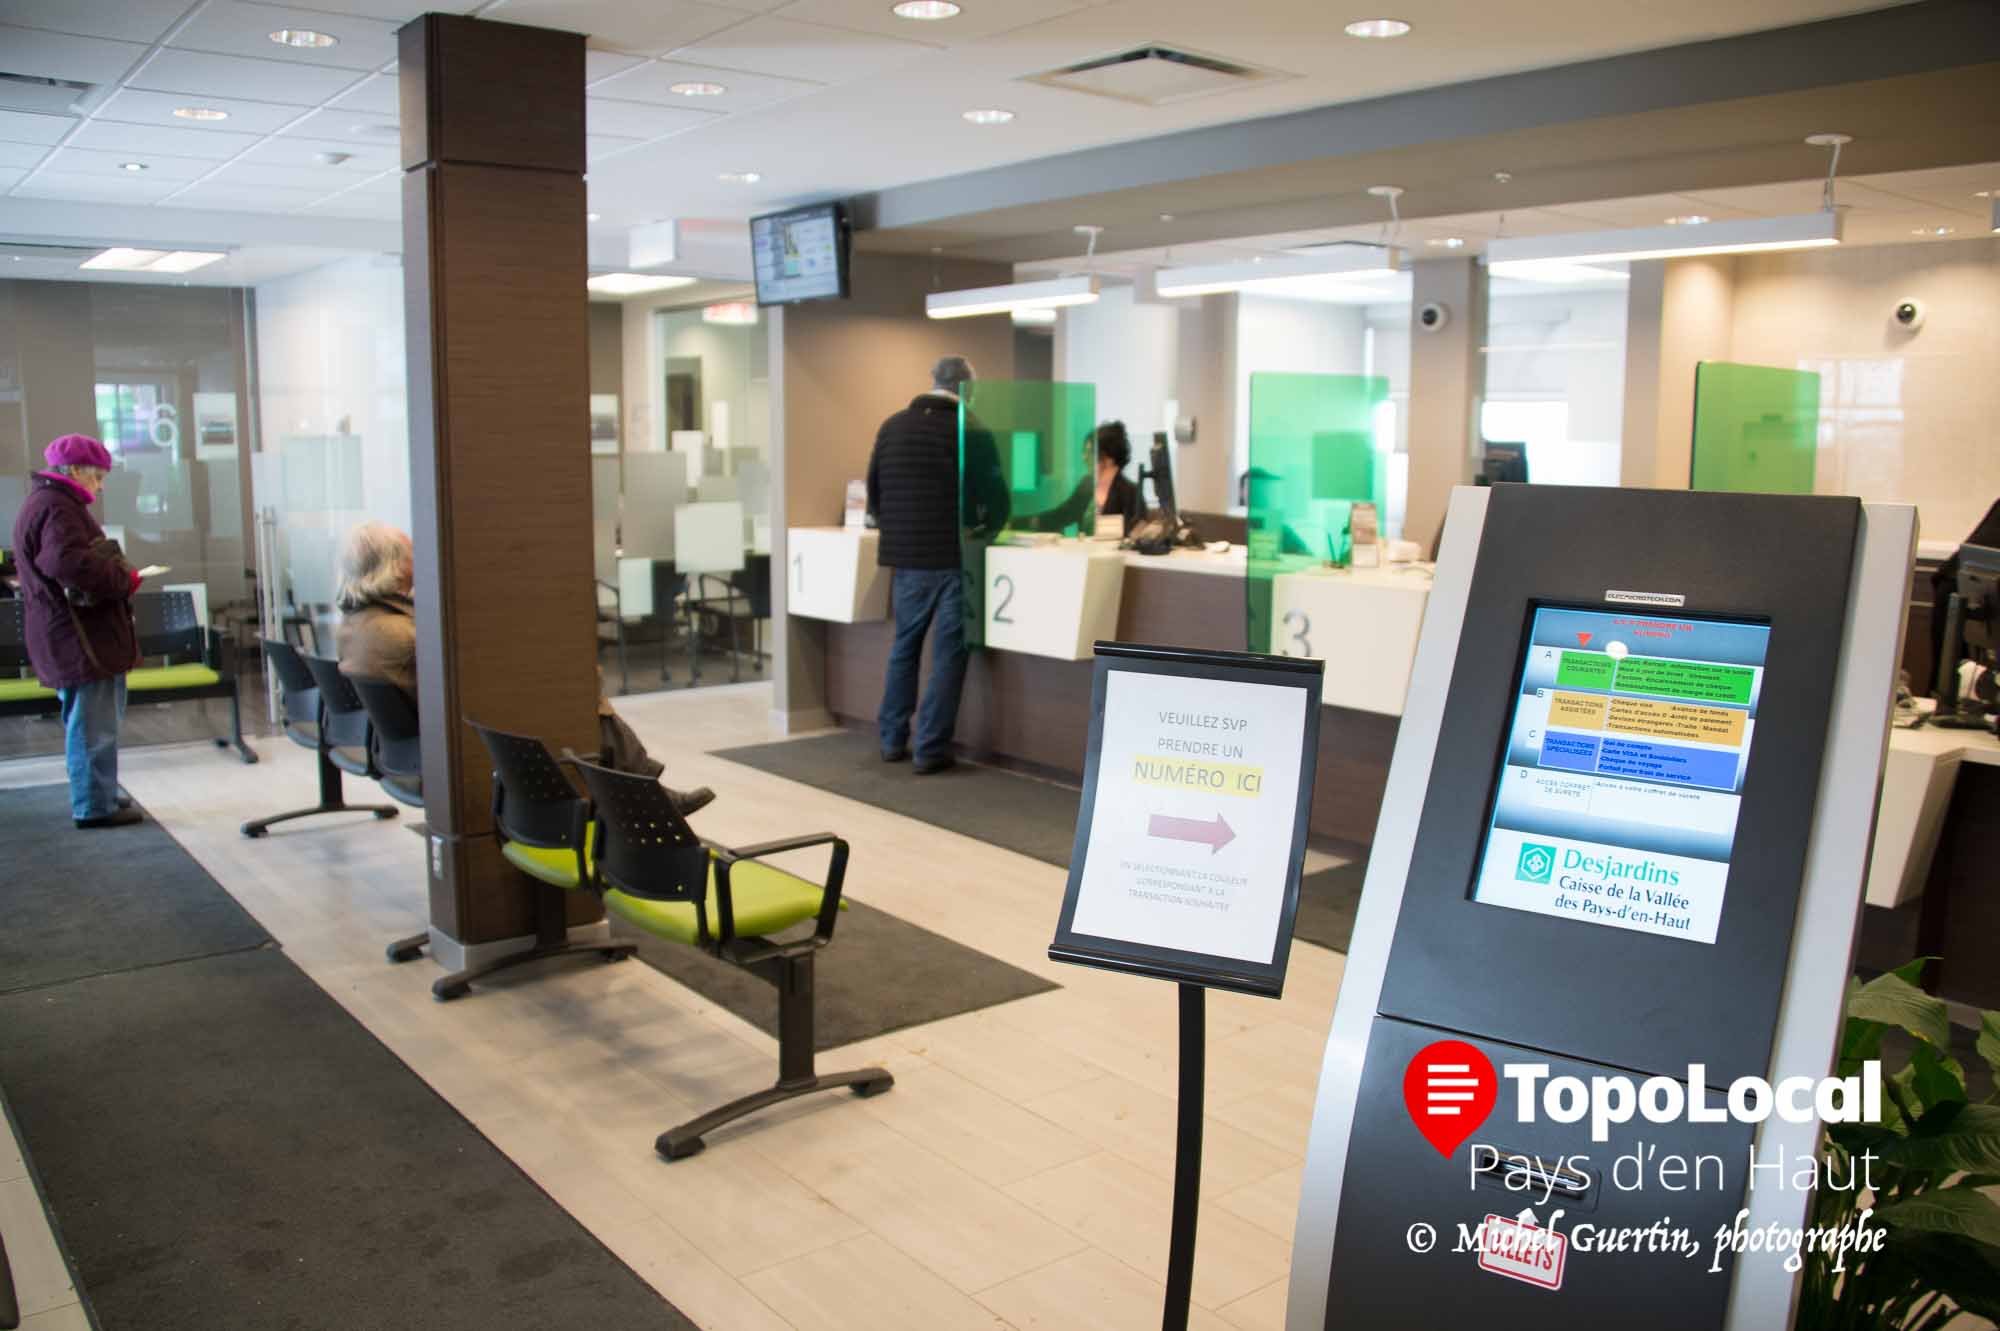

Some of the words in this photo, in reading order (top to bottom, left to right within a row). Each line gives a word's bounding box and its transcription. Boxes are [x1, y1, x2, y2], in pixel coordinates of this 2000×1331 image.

[993, 574, 1014, 624] 2
[1282, 607, 1313, 657] 3
[1537, 689, 1544, 697] B
[1554, 696, 1603, 708] TRANSACTIONS
[1159, 712, 1218, 729] VEUILLEZ
[1222, 717, 1248, 731] SVP
[1529, 730, 1536, 738] C
[1545, 737, 1595, 749] TRANSACTIONS
[1158, 737, 1219, 756] PRENDRE
[1223, 744, 1244, 759] UN
[1134, 761, 1225, 788] NUMÉRO
[1237, 774, 1262, 793] ICI
[1520, 770, 1528, 778] D
[1563, 849, 1680, 886] Desjardins
[1128, 888, 1182, 904] TRANSACTION
[1559, 875, 1602, 895] Caisse
[1607, 882, 1624, 898] de
[1629, 886, 1641, 901] la
[1646, 889, 1689, 909] Vallée
[1555, 894, 1577, 911] des
[1582, 899, 1691, 930] Pays-d'en-Haut
